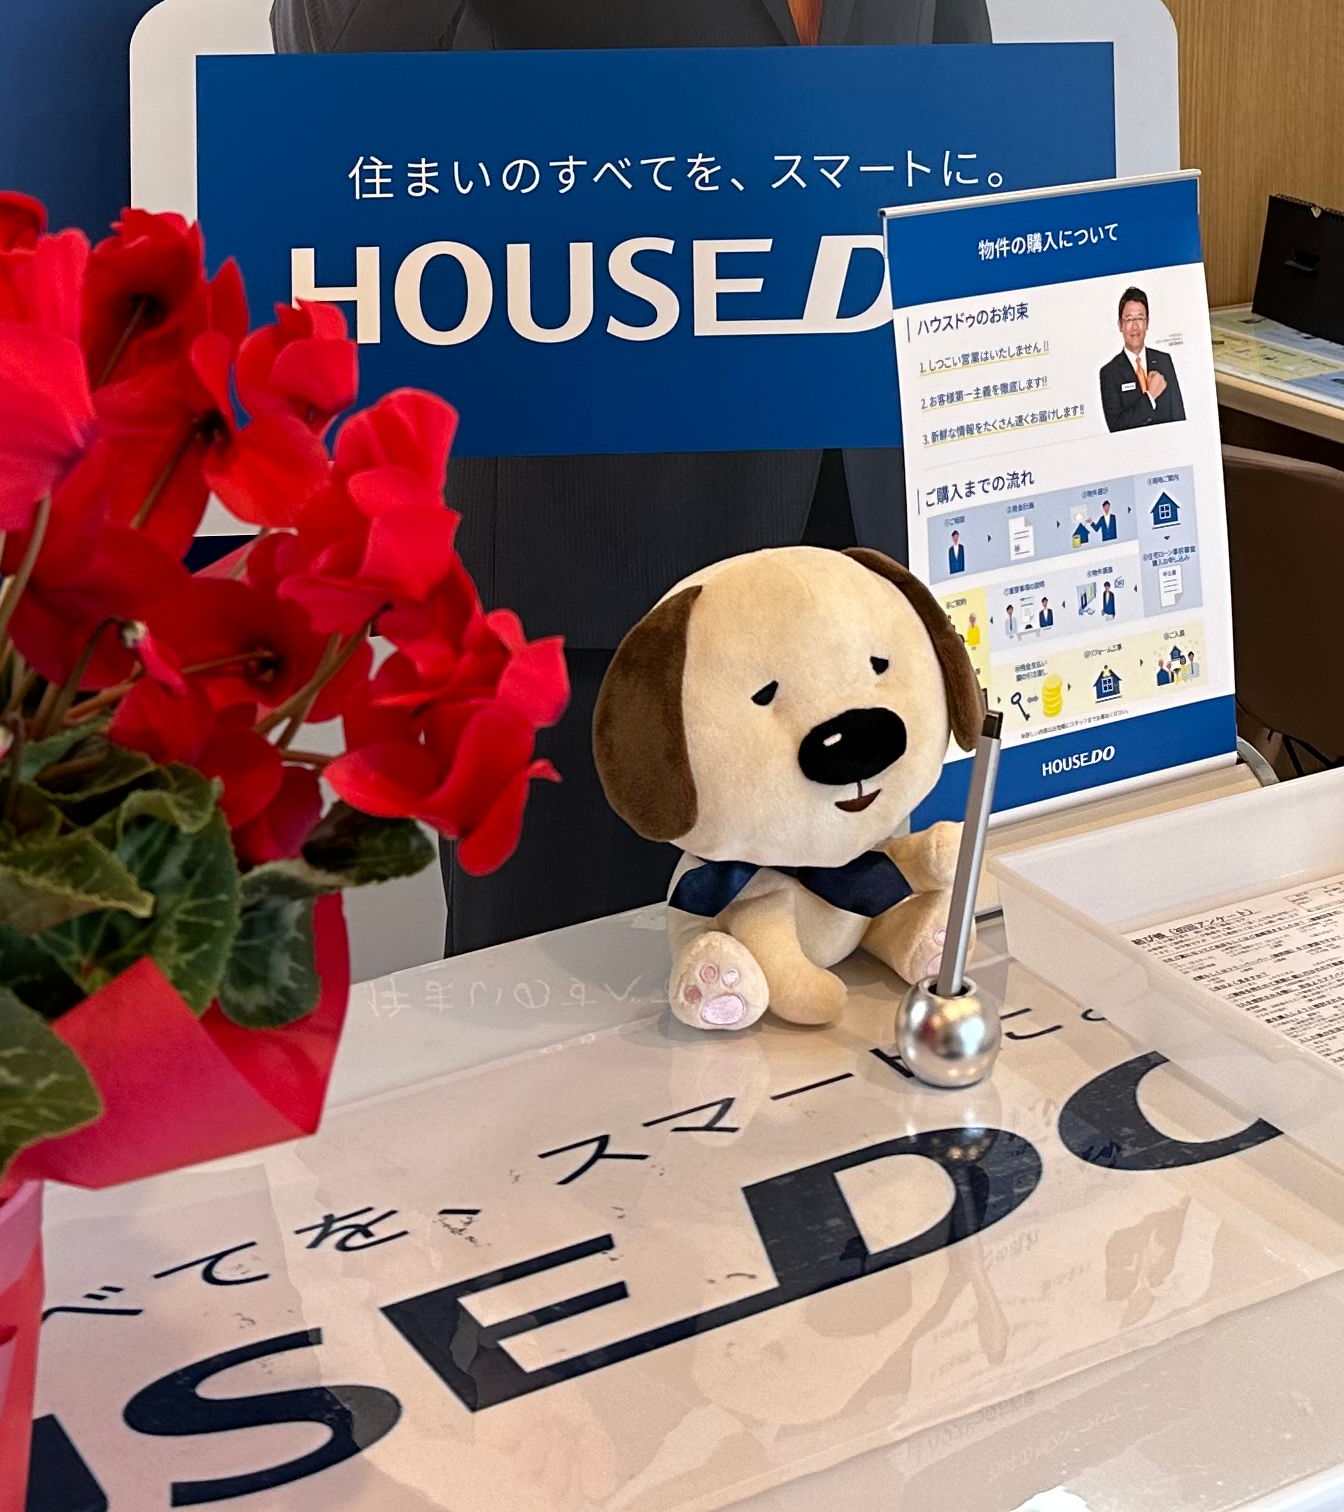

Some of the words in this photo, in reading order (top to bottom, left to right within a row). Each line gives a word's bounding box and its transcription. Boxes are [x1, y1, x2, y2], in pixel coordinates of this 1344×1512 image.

[347, 149, 1006, 202] 住まいのすべてを、スマートに。
[978, 223, 1119, 261] 物件の購入について
[917, 302, 1029, 336] ハウスドゥのお約束
[925, 470, 1035, 508] ご購入までの流れ
[1042, 745, 1115, 776] HOUSEDO
